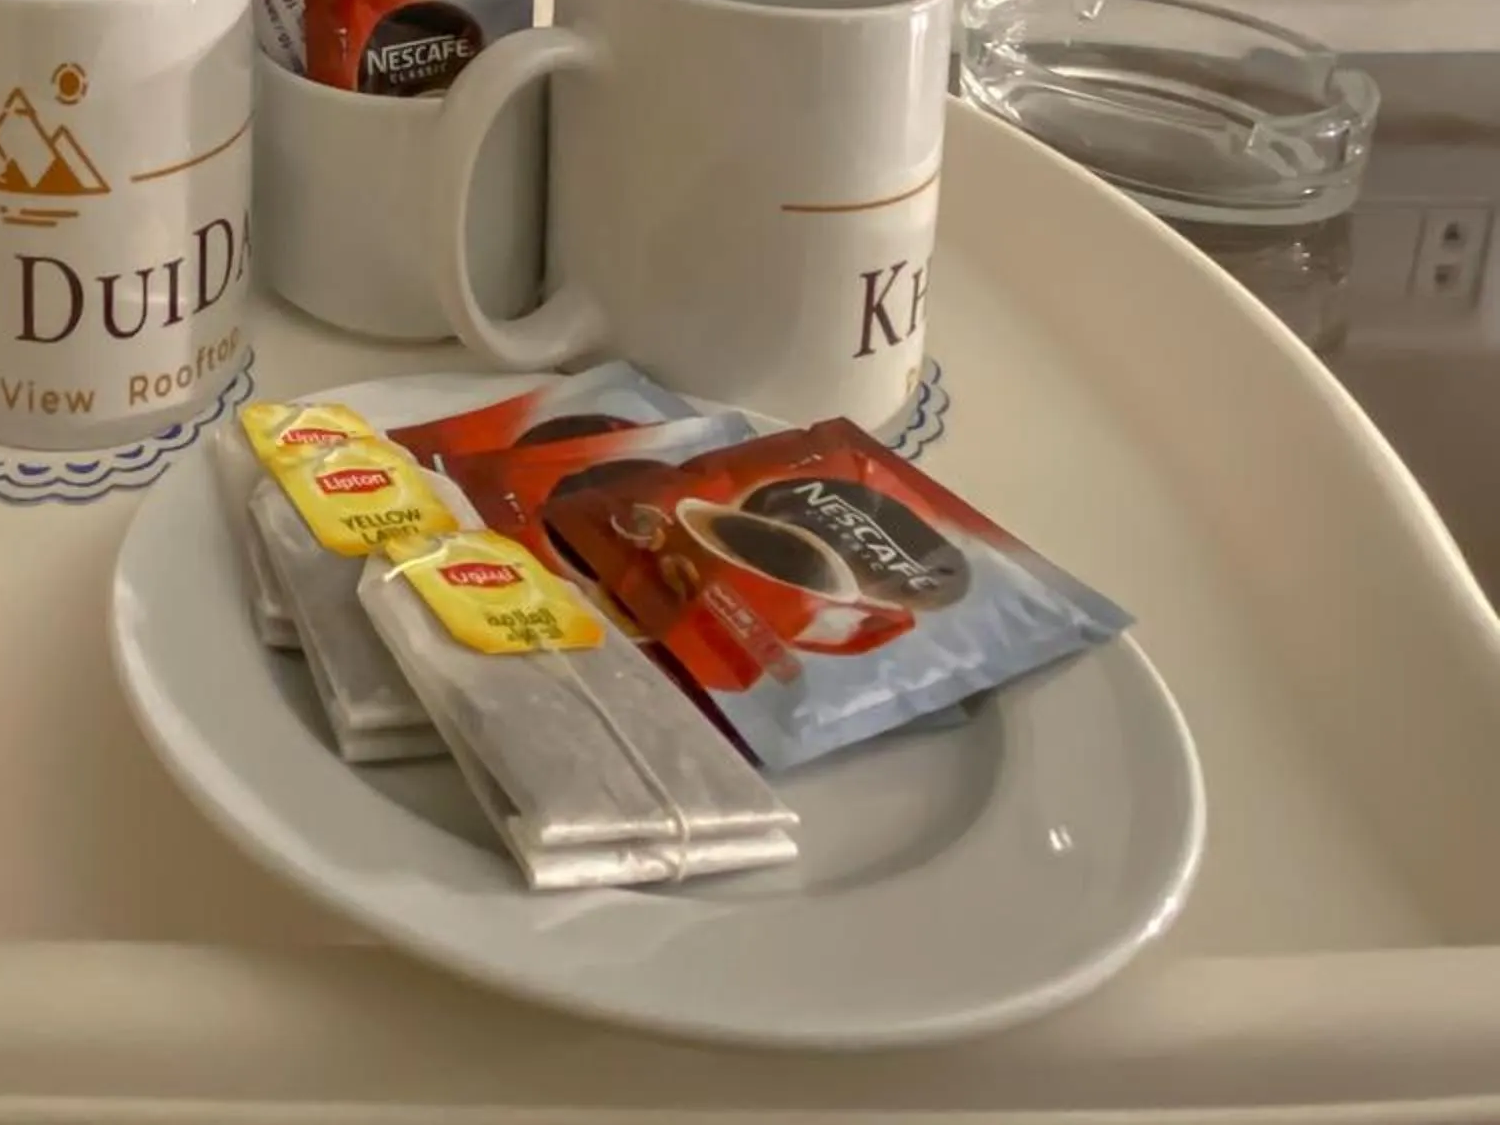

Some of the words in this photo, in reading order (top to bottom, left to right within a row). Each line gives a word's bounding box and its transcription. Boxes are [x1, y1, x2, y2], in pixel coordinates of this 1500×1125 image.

[0, 376, 95, 413] View
[323, 473, 386, 491] Lipton
[340, 509, 421, 531] YELLOW
